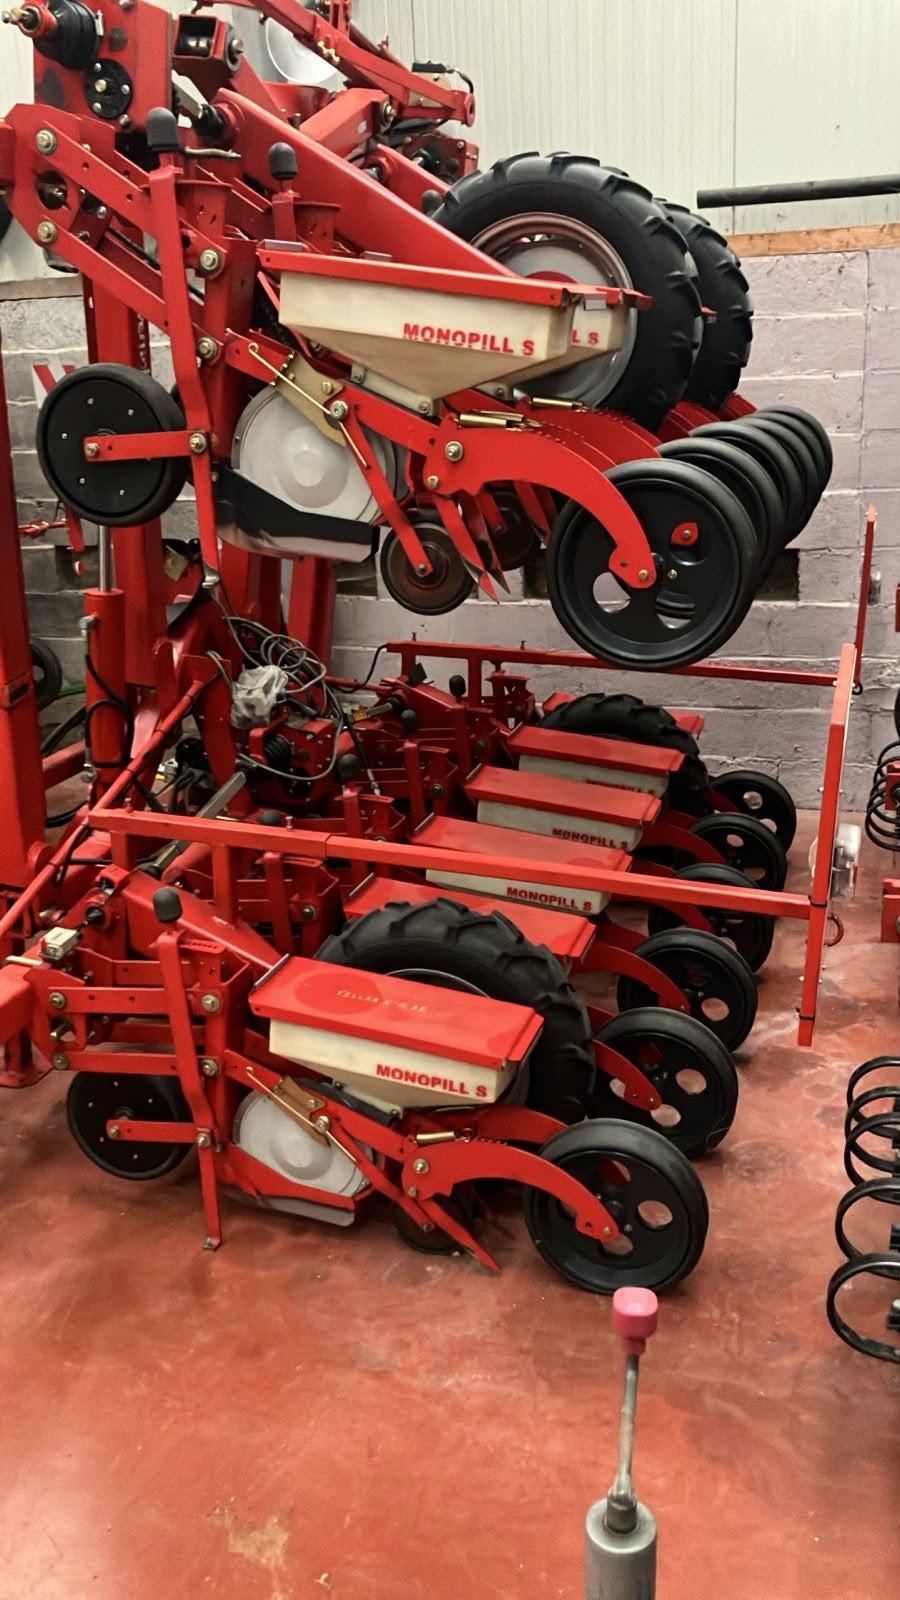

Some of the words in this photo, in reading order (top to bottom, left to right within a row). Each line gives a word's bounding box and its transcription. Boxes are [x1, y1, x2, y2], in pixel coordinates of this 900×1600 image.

[404, 323, 514, 354] MONOPILL
[522, 340, 535, 356] S
[588, 332, 600, 345] S
[552, 827, 616, 848] MONOPILL
[507, 887, 578, 909] MONOPILL
[583, 902, 593, 911] S
[376, 1064, 468, 1095] MONOPILL
[475, 1085, 487, 1097] S
